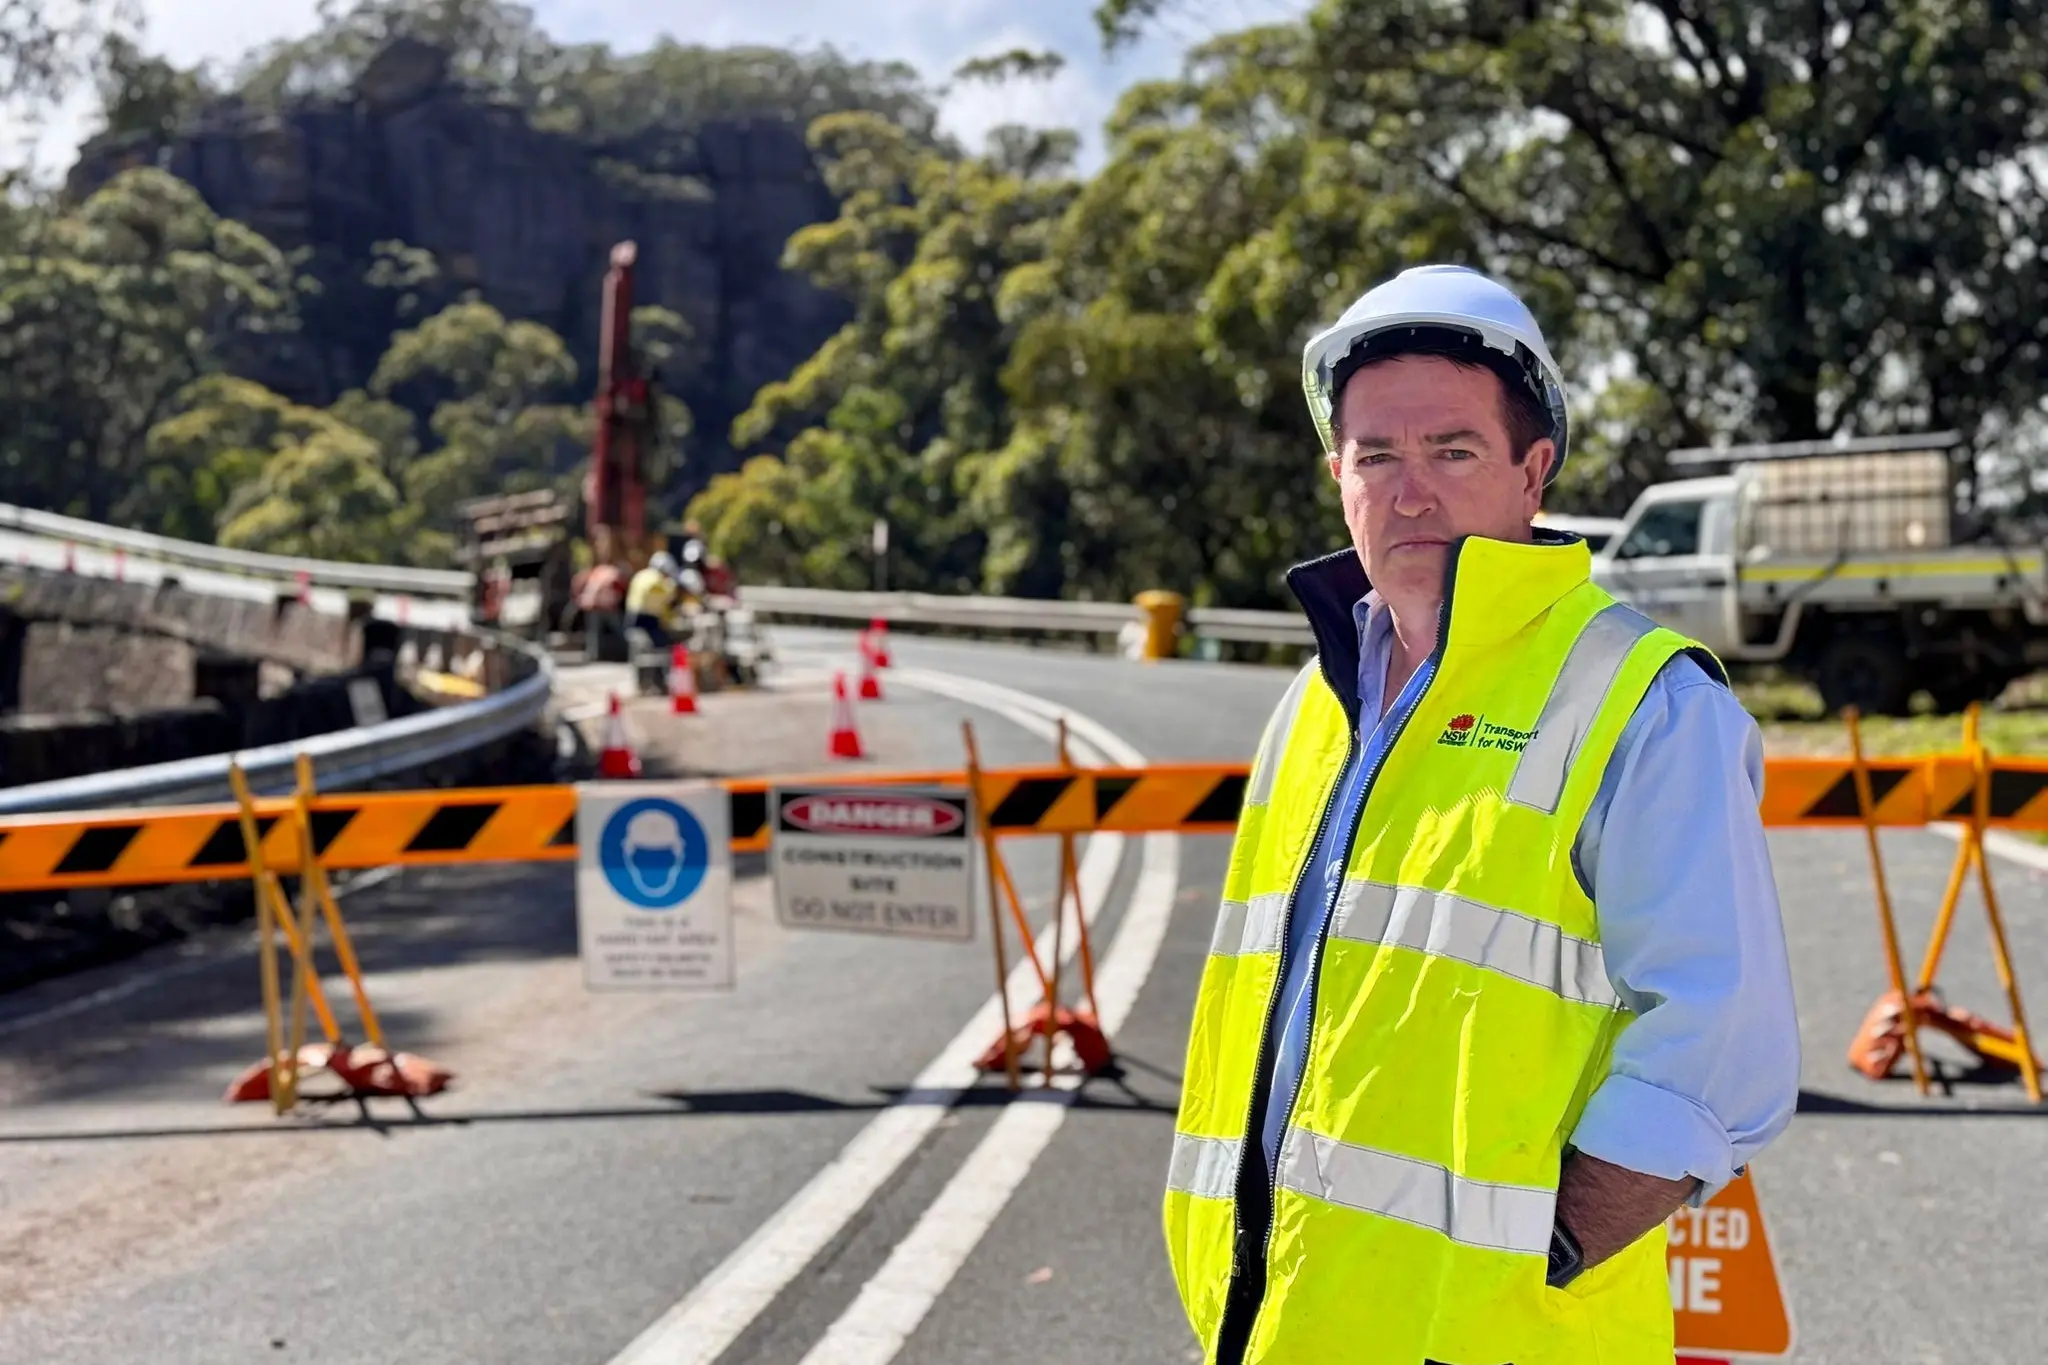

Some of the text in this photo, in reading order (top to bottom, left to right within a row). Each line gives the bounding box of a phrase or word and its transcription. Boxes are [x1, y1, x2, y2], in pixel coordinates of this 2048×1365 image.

[1441, 730, 1470, 741] NSW
[1484, 724, 1539, 740] Transport
[1478, 737, 1494, 748] for
[1496, 739, 1527, 752] NSW
[810, 801, 935, 829] DANGER
[830, 900, 876, 922] NOT
[882, 903, 960, 928] ENTER
[1667, 1206, 1748, 1250] CTED
